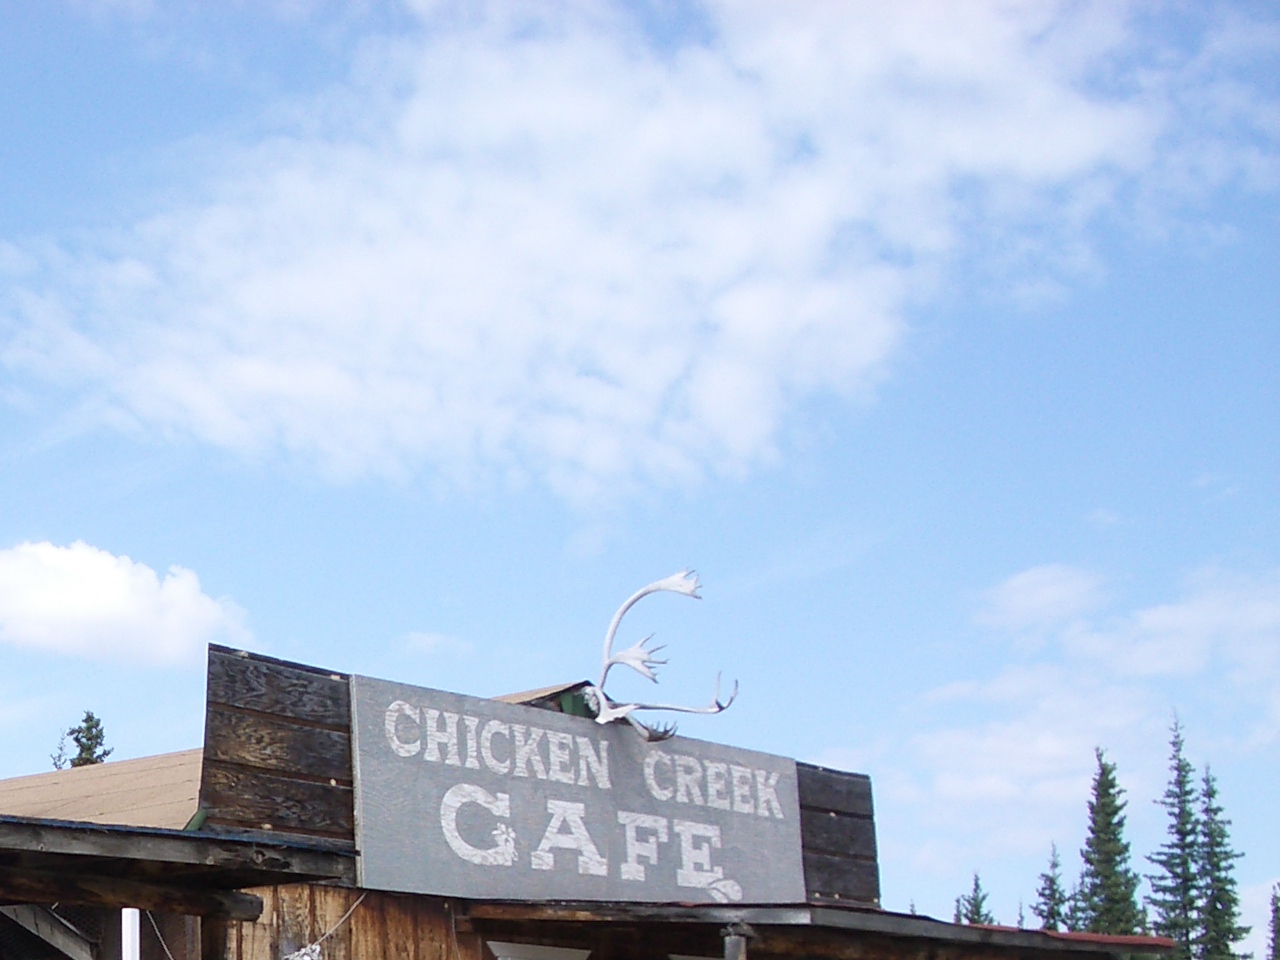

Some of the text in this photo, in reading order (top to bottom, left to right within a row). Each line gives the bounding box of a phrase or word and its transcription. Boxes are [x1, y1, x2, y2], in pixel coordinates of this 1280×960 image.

[384, 700, 785, 820] CHICKEN CREEK
[440, 783, 726, 890] CAFE
